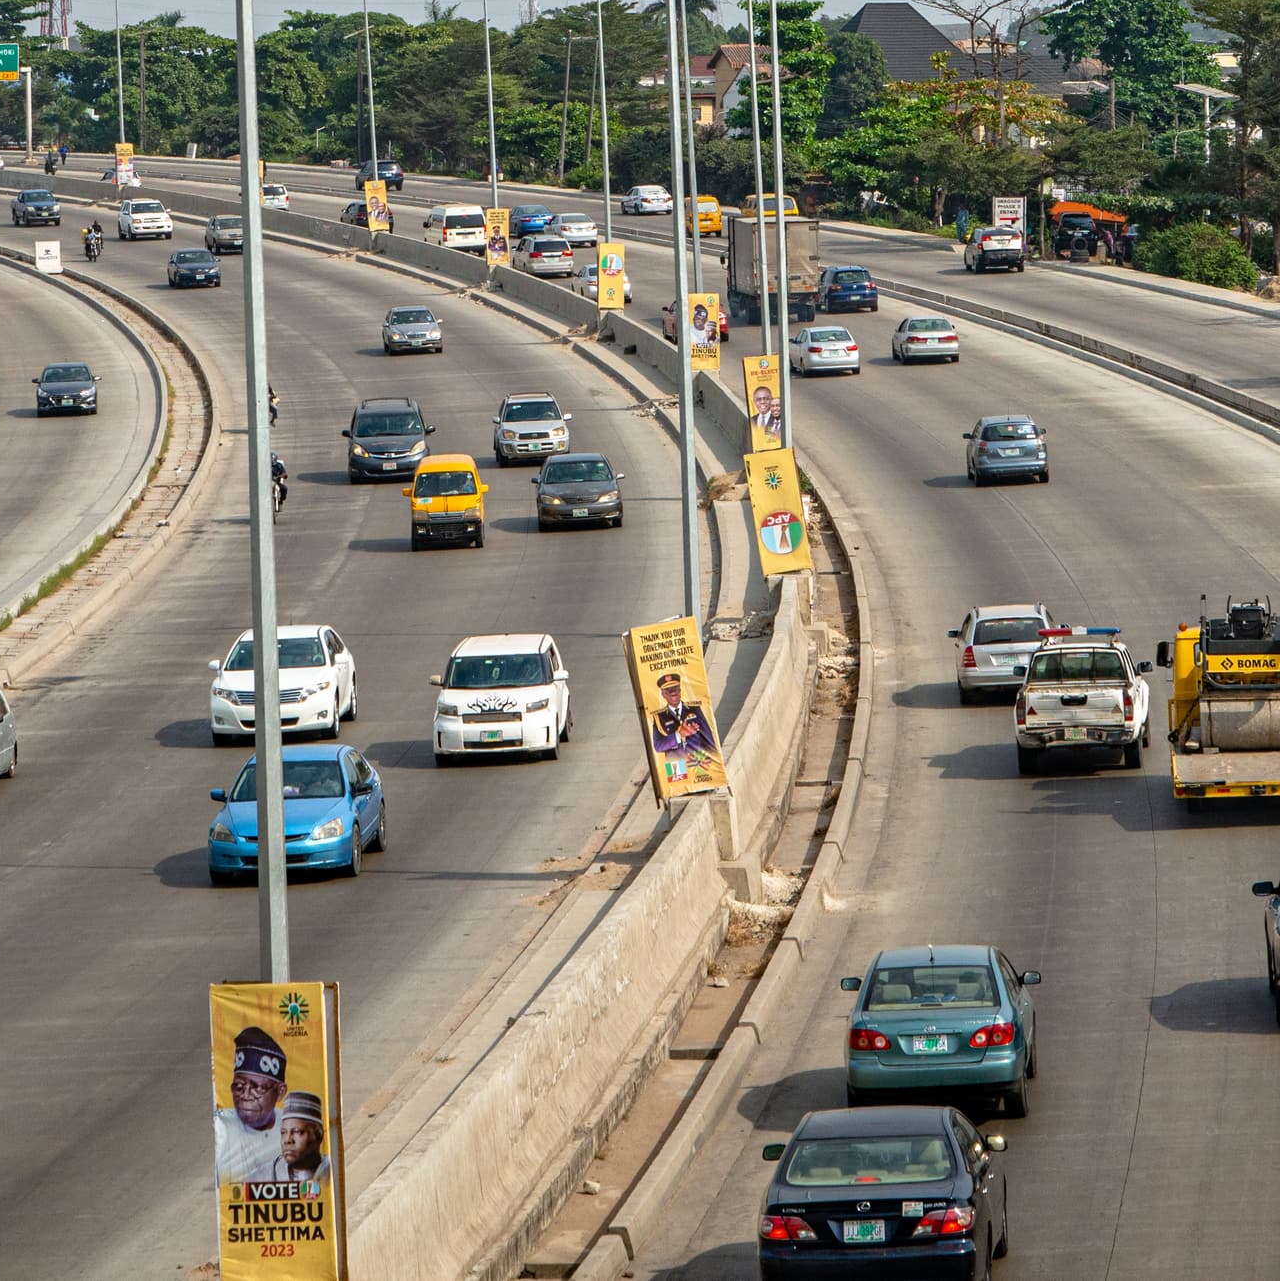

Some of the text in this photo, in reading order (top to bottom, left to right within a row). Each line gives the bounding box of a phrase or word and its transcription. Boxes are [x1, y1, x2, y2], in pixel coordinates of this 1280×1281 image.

[767, 513, 791, 525] APC
[640, 627, 686, 643] THANK YOU OUR
[643, 637, 686, 653] GOVERNOR FOR
[640, 646, 694, 663] MAKING OUR STATE
[649, 657, 688, 671] EXCEPTIONAL
[1237, 659, 1276, 668] BOMAG
[251, 1183, 298, 1199] VOTE
[228, 1202, 324, 1225] TINUBU
[228, 1225, 325, 1243] SHETTIMA
[261, 1244, 295, 1257] 2023
